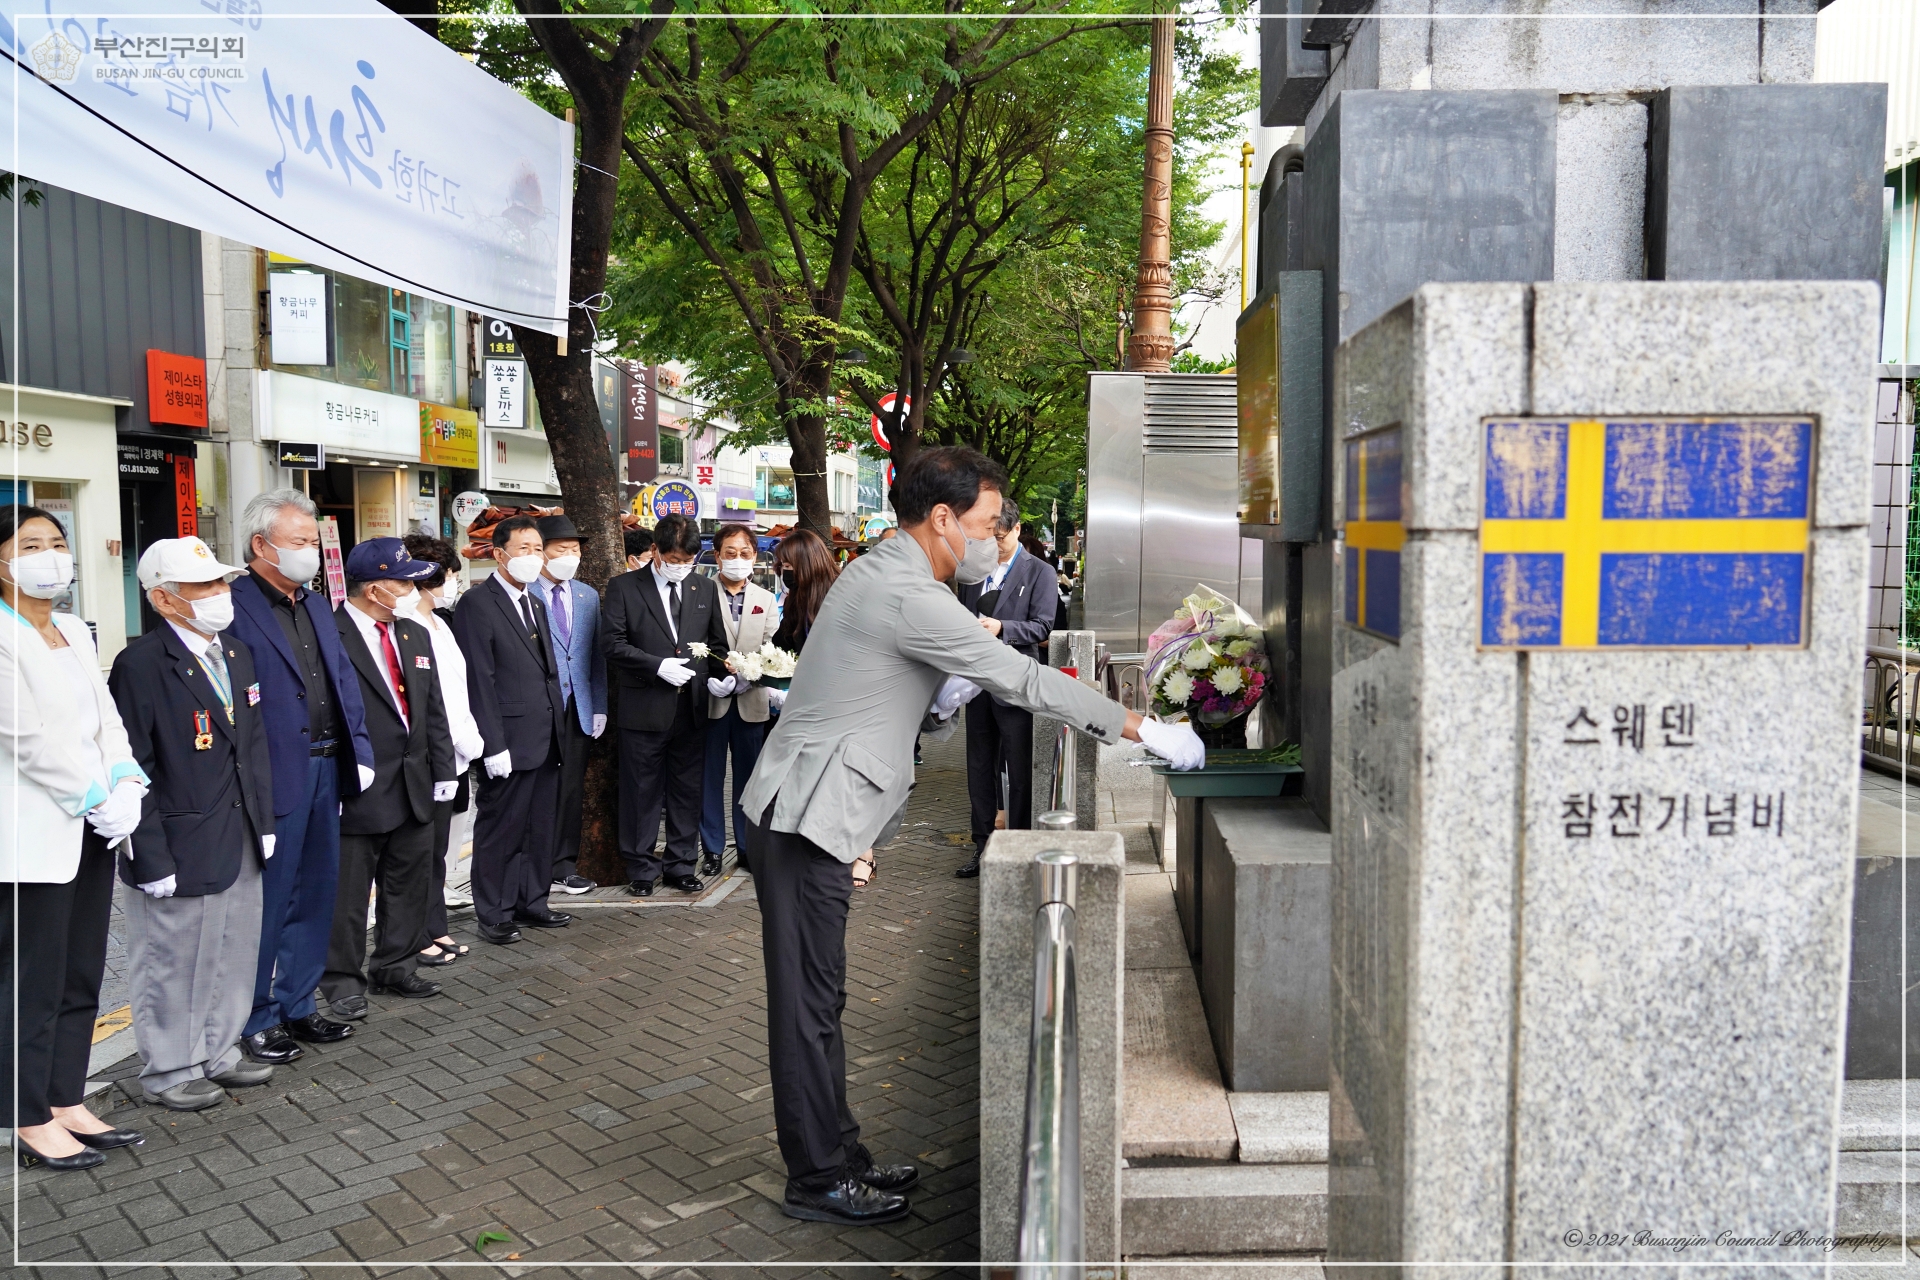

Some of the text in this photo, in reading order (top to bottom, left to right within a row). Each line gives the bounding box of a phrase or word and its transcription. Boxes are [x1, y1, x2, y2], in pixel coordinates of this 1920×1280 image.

[279, 297, 318, 307] 황금나무
[290, 309, 308, 319] 커피
[489, 342, 515, 353] 1호점
[164, 370, 202, 390] 제이스타
[165, 389, 203, 409] 성형외과
[498, 386, 512, 422] 돈까스
[326, 401, 379, 427] 황금나무커피
[629, 449, 655, 458] 819-4420
[119, 464, 159, 474] 051.818.7005
[697, 466, 714, 485] 꽃
[178, 461, 194, 536] 제이스타
[655, 501, 696, 516] 상품권
[1563, 703, 1697, 751] 스웨덴
[1560, 791, 1786, 838] 참전기념비
